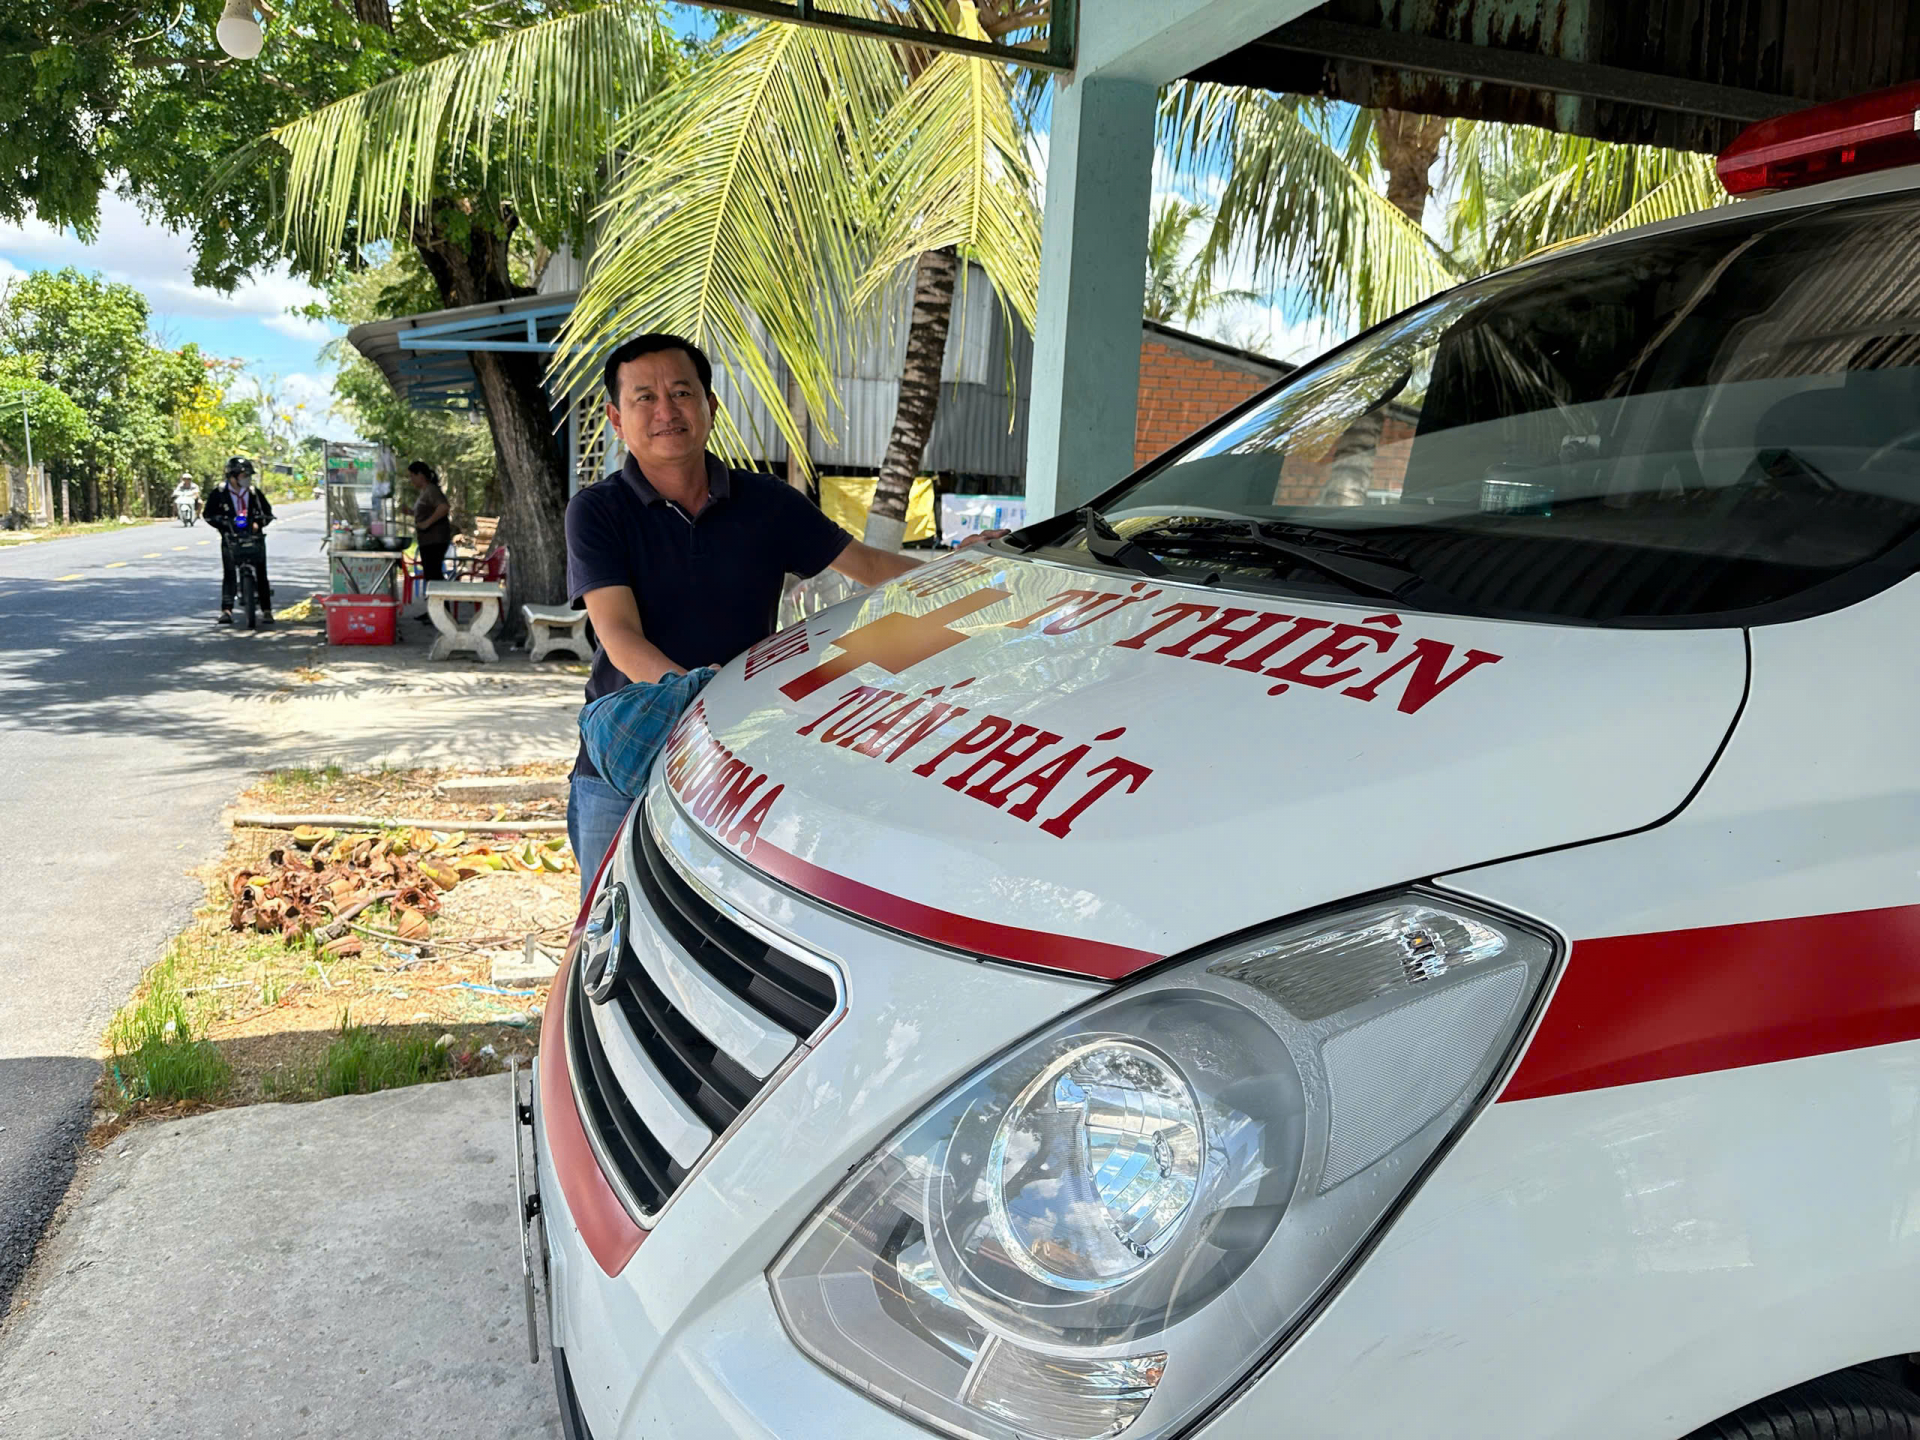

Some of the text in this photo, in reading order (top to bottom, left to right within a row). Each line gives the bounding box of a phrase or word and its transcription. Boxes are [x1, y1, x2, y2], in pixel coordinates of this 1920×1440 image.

[1004, 582, 1164, 636] TỪ
[1112, 602, 1505, 715] THIỆN
[795, 677, 977, 764] TUẤN
[911, 715, 1154, 840] PHÁT
